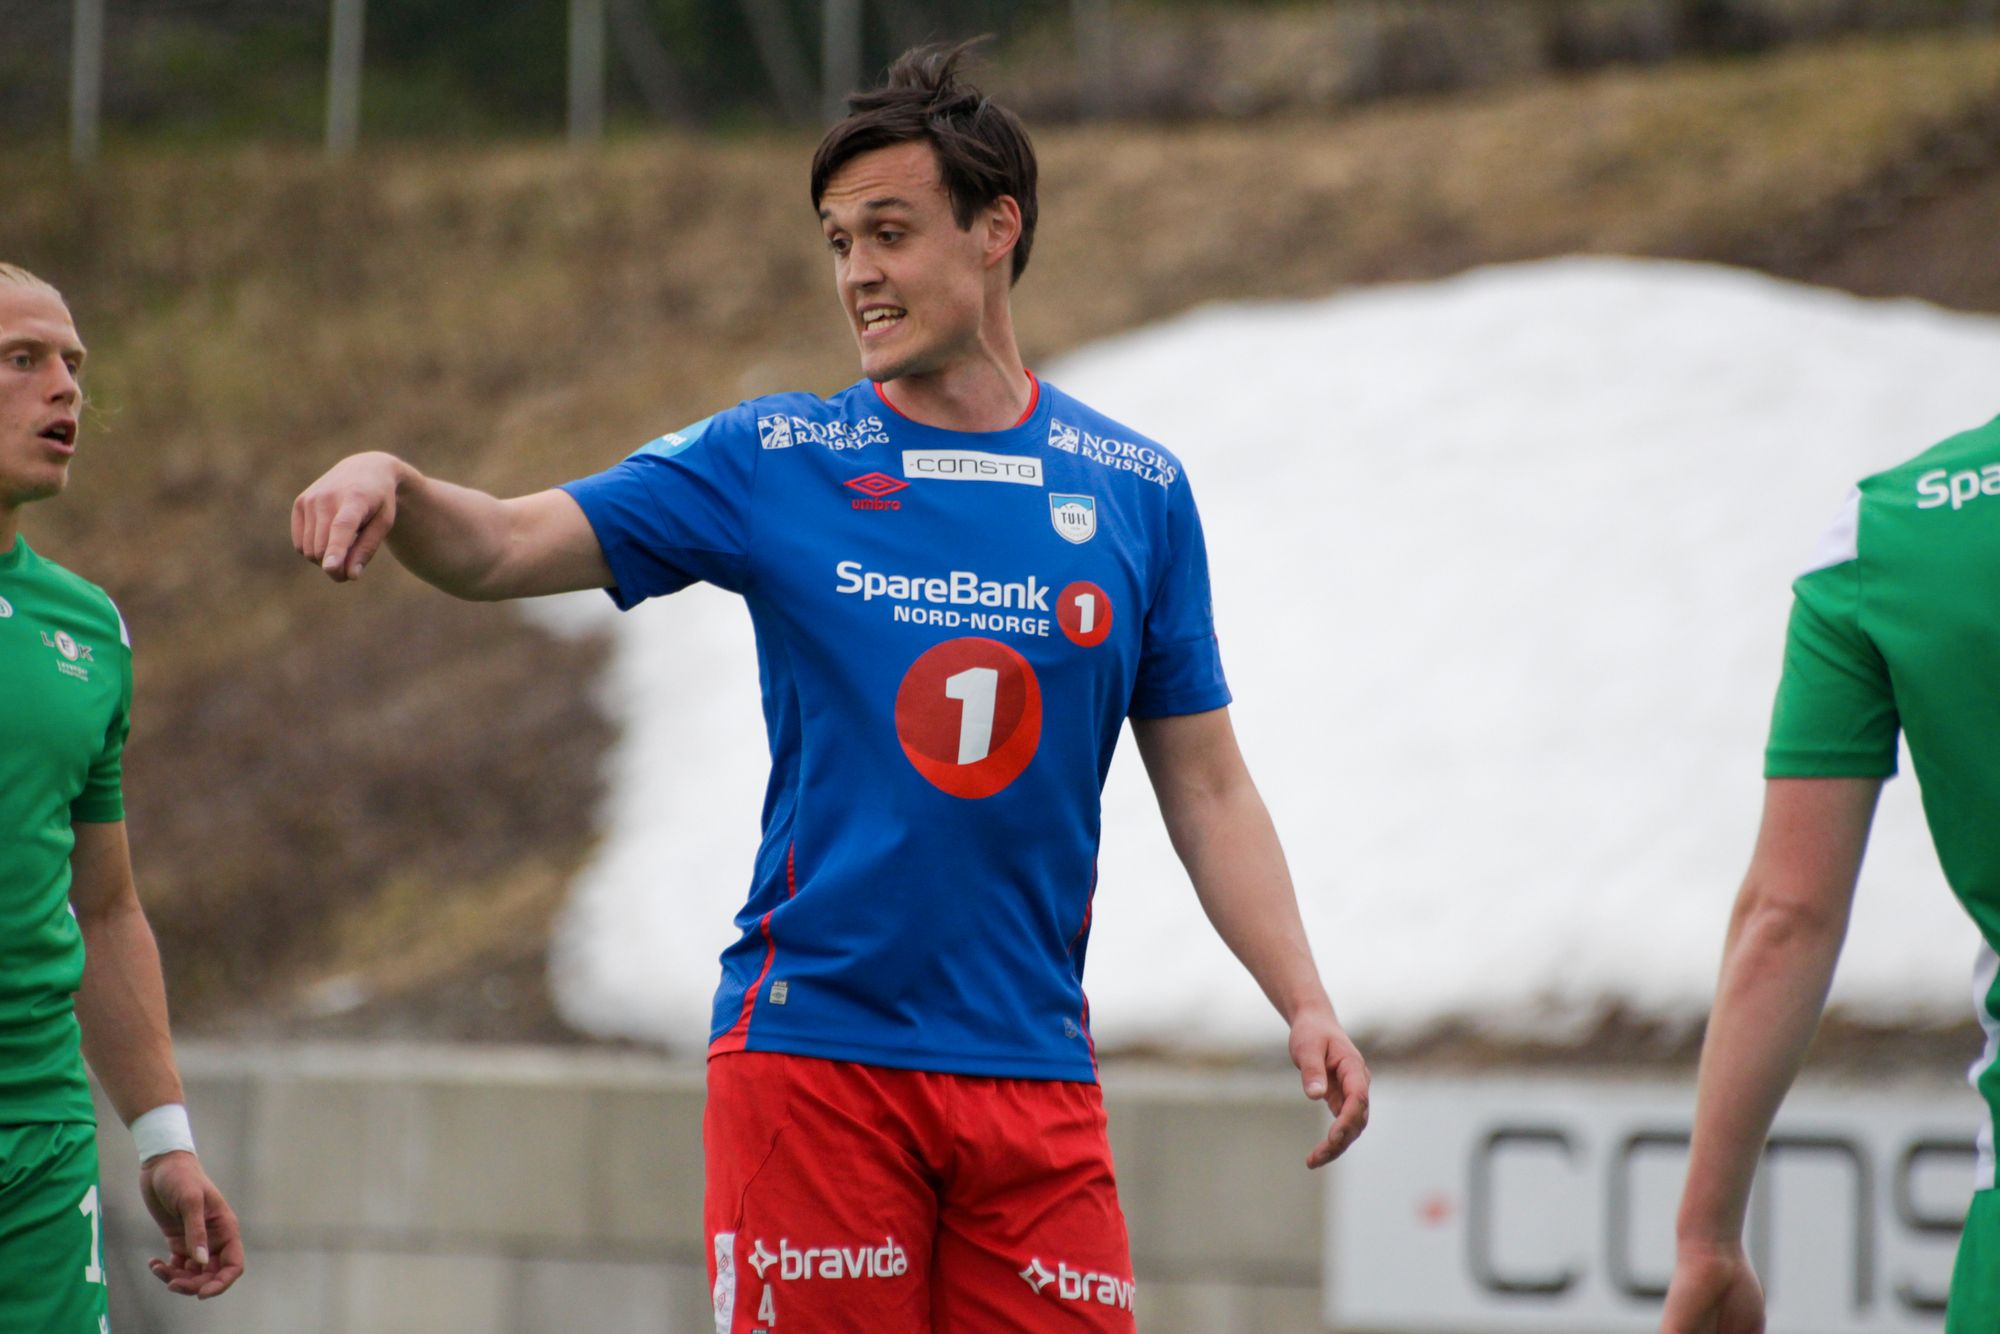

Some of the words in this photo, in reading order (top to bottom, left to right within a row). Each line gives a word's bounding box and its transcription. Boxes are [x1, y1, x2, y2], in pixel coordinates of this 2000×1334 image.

[790, 415, 883, 441] NORGES
[1082, 431, 1177, 484] NORGES
[852, 497, 901, 511] umbro
[1061, 512, 1088, 526] TUIL
[835, 560, 1050, 612] SpareBank
[1074, 592, 1095, 634] 1
[893, 604, 1050, 637] NORD-NORGE
[945, 667, 998, 765] 1
[79, 1184, 106, 1286] 1
[779, 1236, 908, 1280] bravida
[757, 1284, 776, 1328] 4
